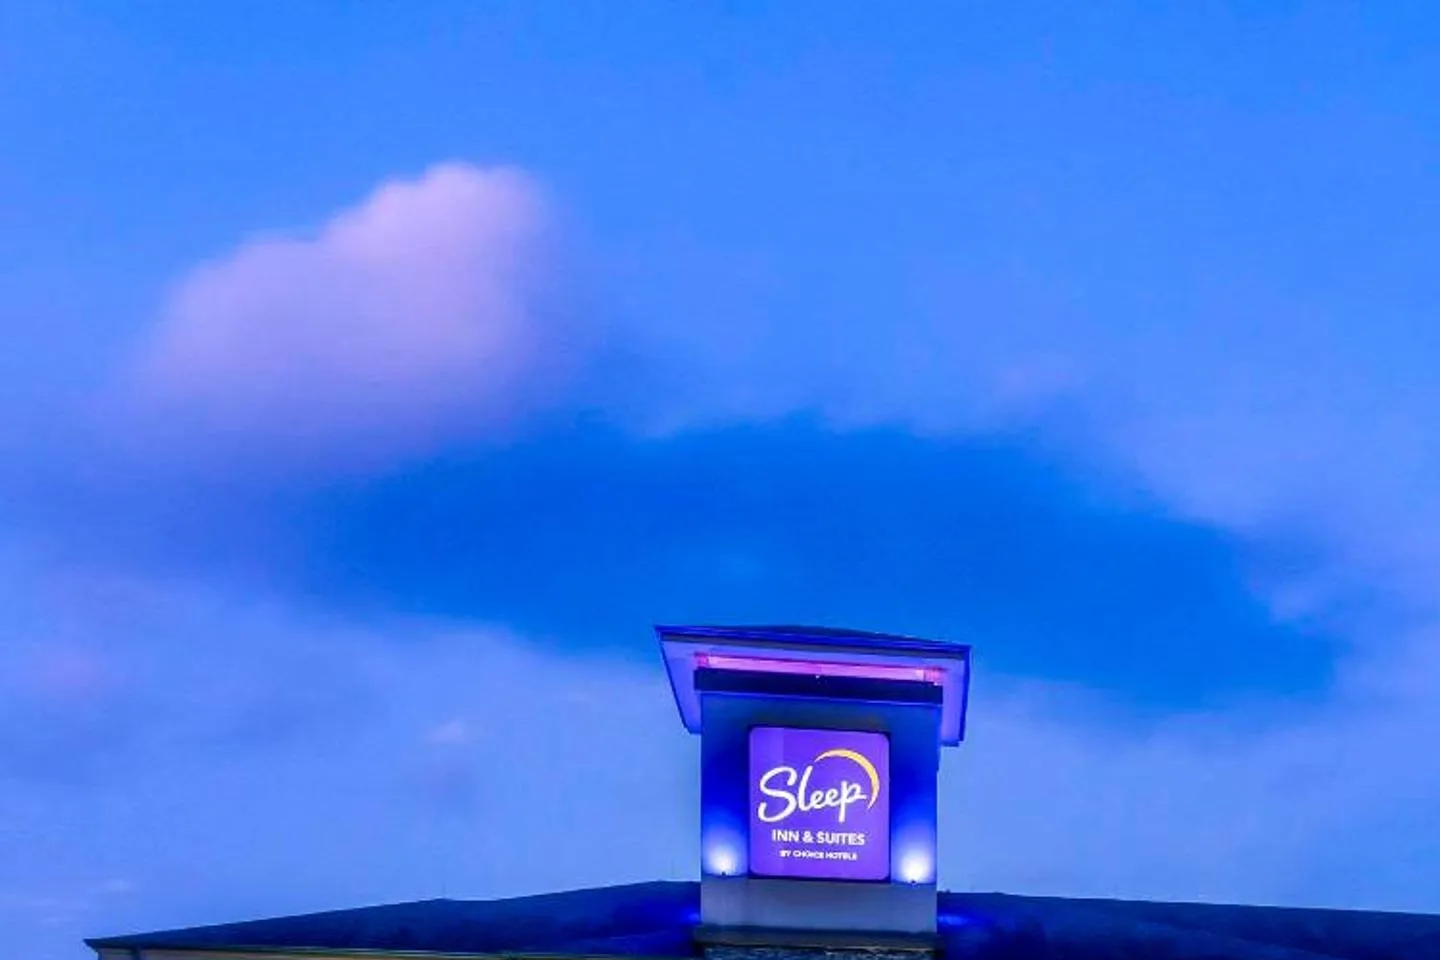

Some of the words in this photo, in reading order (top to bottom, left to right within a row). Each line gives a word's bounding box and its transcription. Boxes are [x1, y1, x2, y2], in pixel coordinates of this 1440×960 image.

[758, 765, 867, 823] Sleep
[772, 829, 799, 843] INN
[802, 830, 814, 843] &
[817, 831, 865, 846] SUITES
